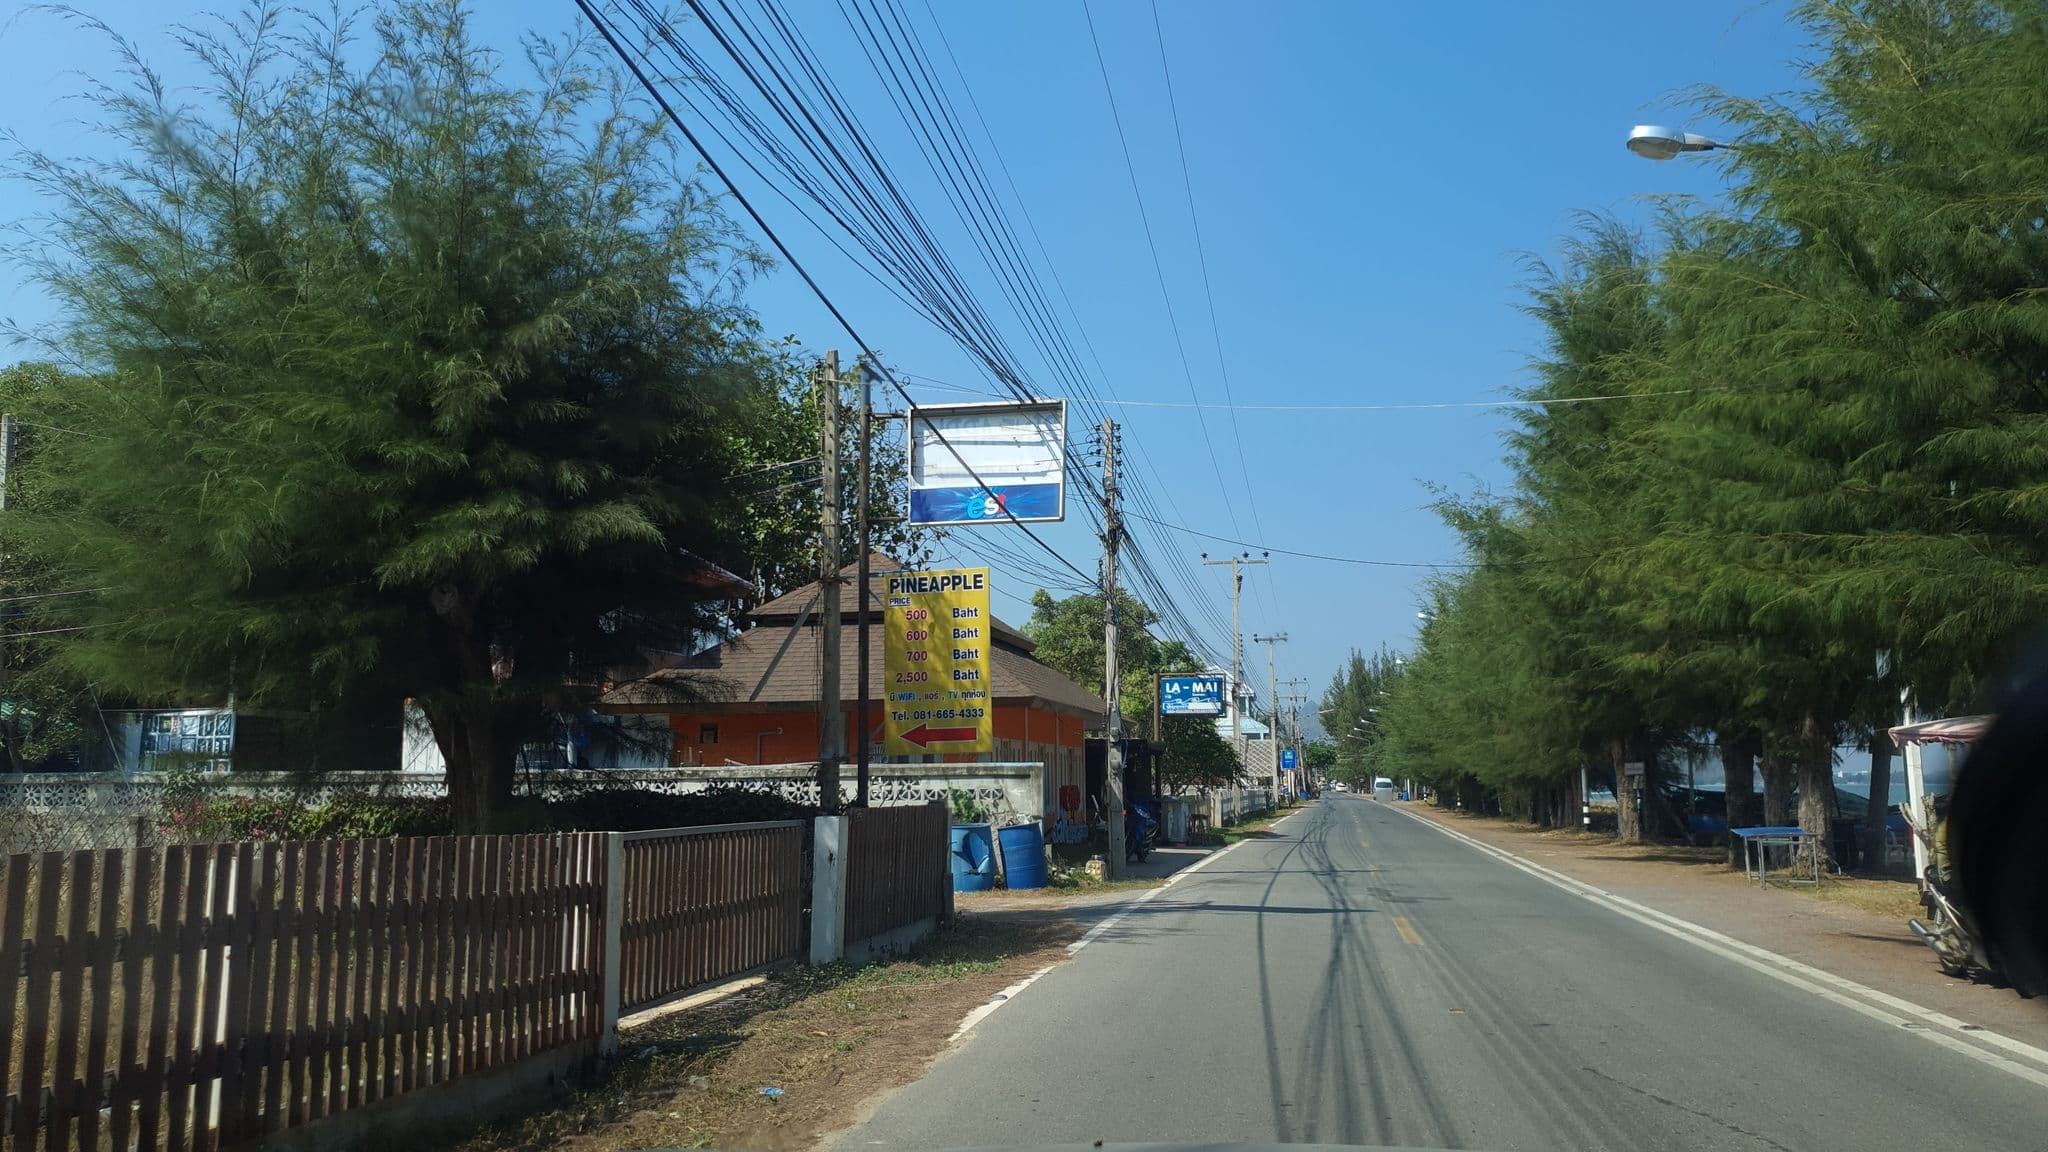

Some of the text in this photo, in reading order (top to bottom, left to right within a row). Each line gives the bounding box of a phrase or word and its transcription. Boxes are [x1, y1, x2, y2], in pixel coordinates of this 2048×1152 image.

[889, 573, 984, 594] PINEAPPLE
[889, 597, 911, 605] PRICE
[906, 607, 979, 620] 500 Baht
[906, 628, 979, 641] 600 Baht
[906, 648, 979, 661] 700 Baht
[896, 669, 980, 684] 2,500 Baht
[1165, 682, 1181, 694] LA
[1192, 681, 1218, 693] MAI
[948, 691, 959, 699] TV
[891, 708, 984, 721] Tel. 081-665-4333
